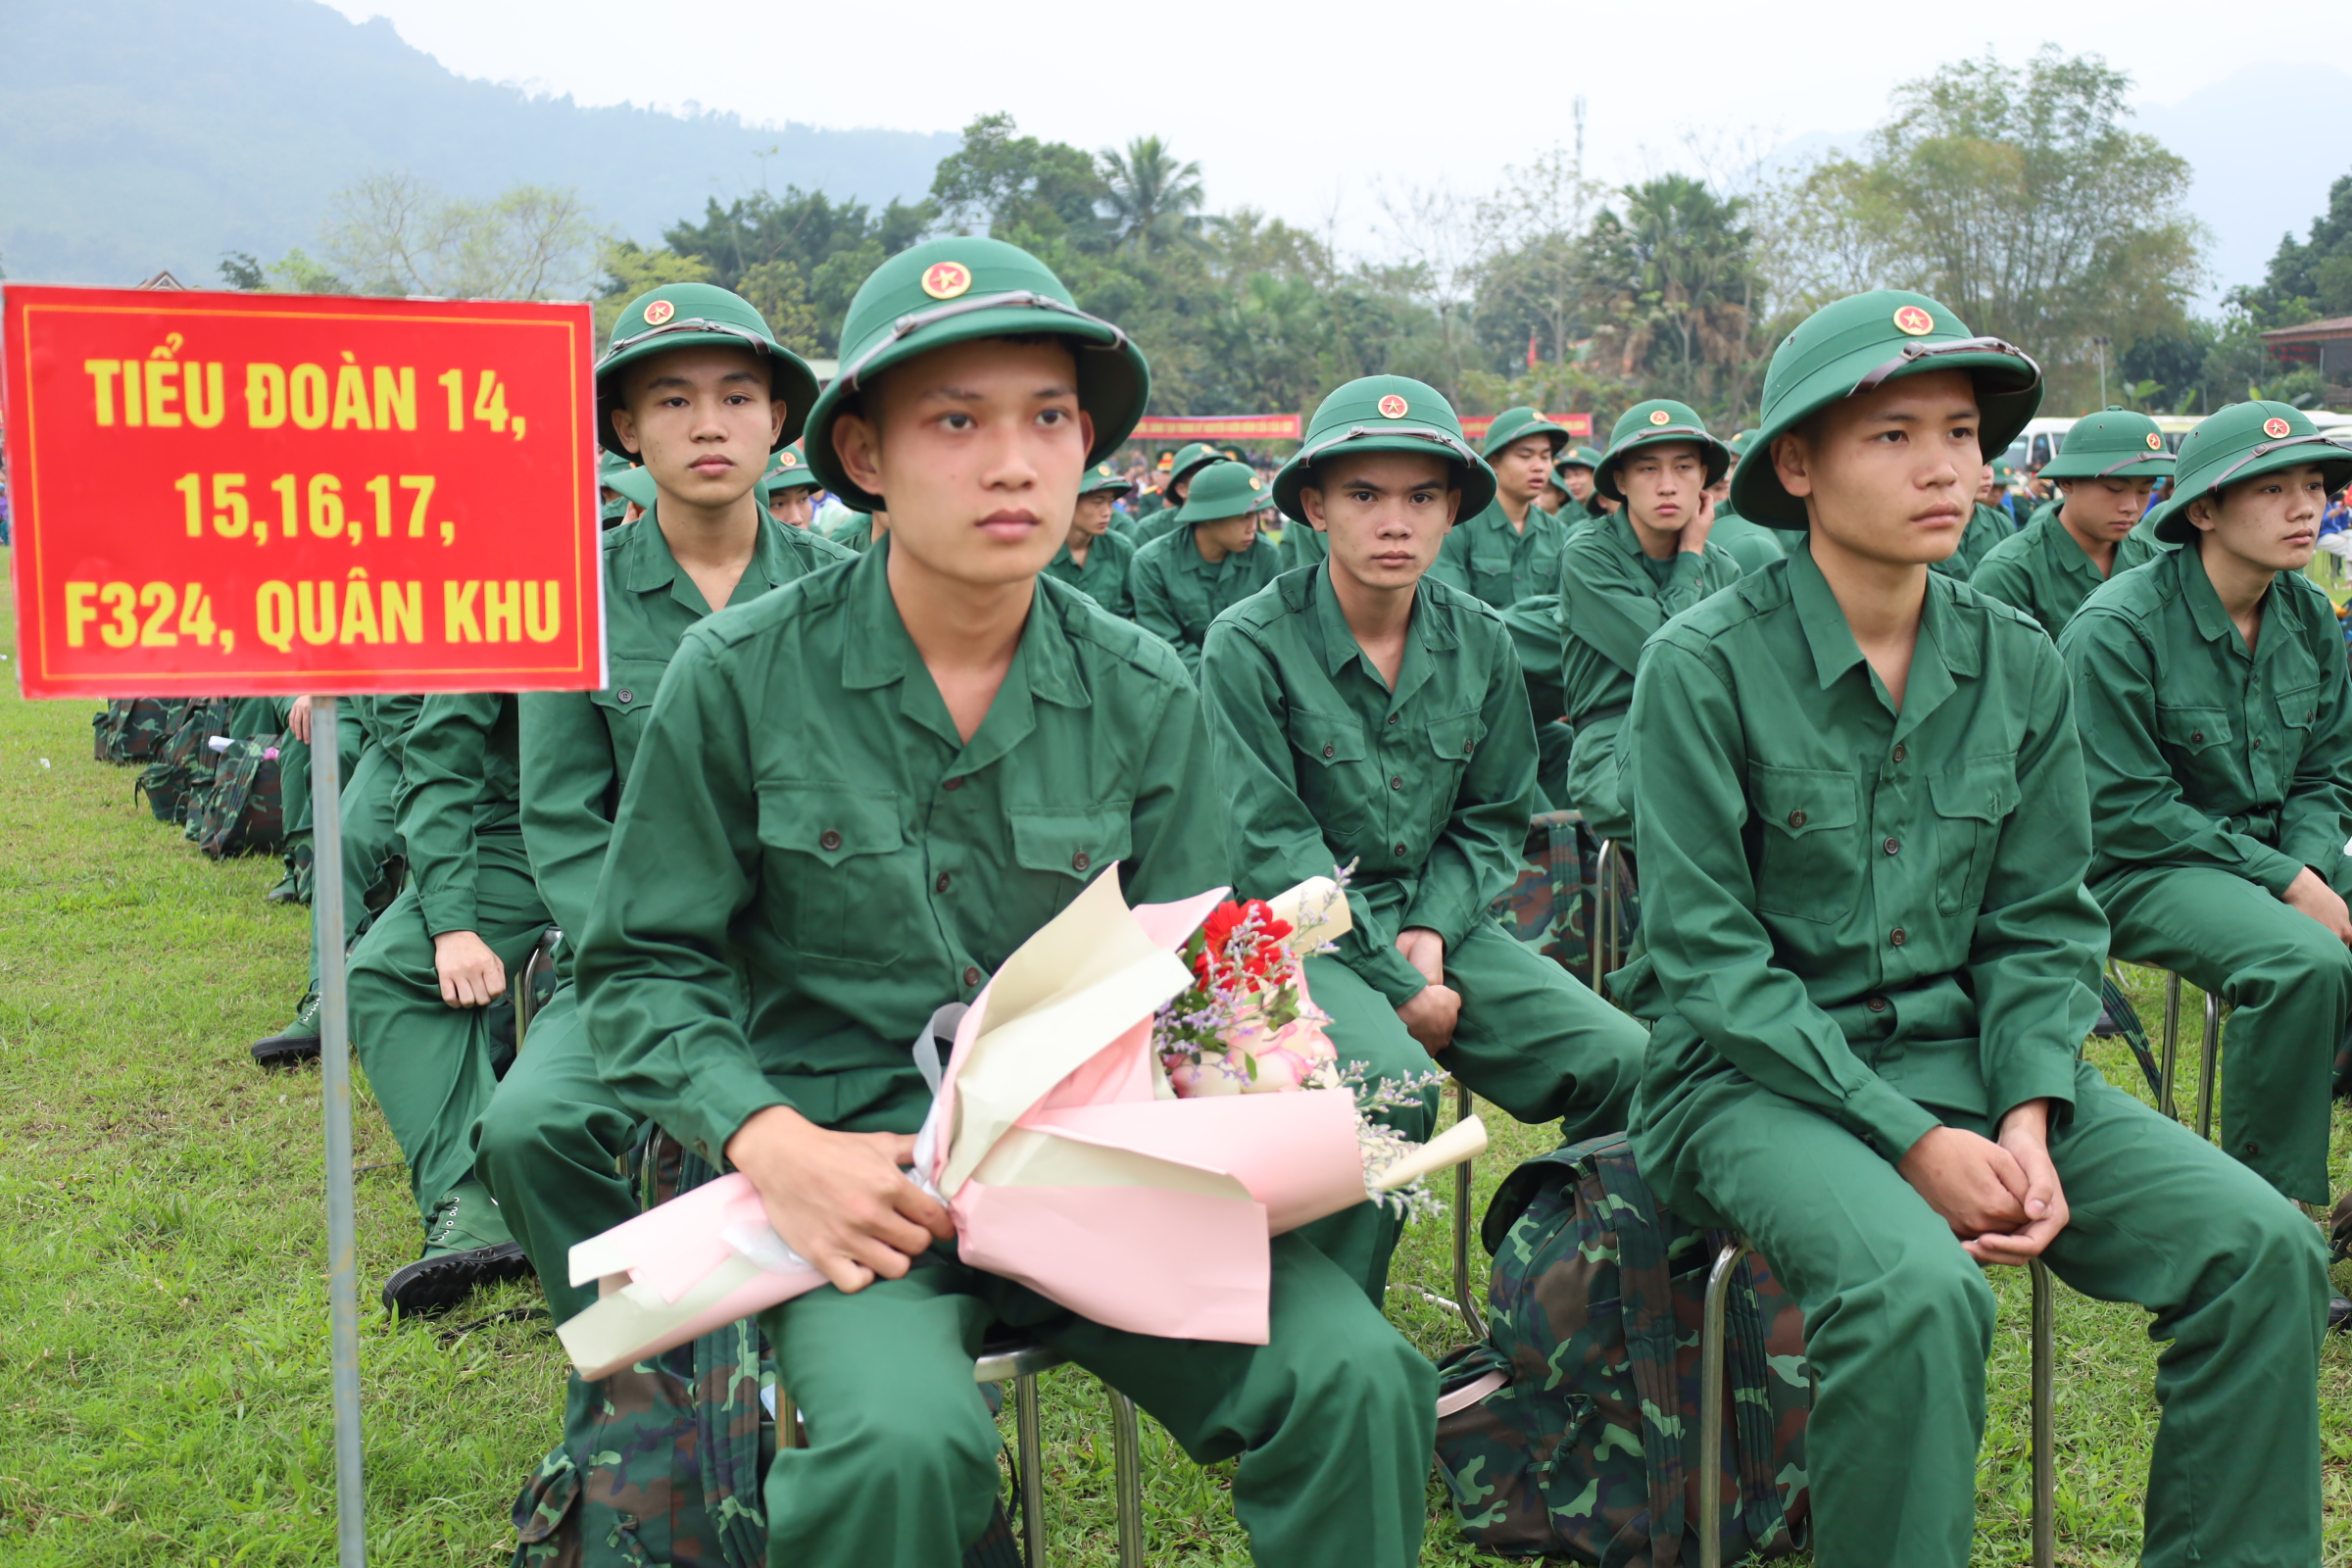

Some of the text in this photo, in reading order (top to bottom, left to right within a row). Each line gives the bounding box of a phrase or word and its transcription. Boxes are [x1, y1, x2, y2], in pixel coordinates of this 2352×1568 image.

[85, 332, 526, 441] TIỂU ĐOÀN 14,
[174, 472, 455, 546] 15,16,17,
[65, 566, 561, 654] F324, QUÂN KHU
